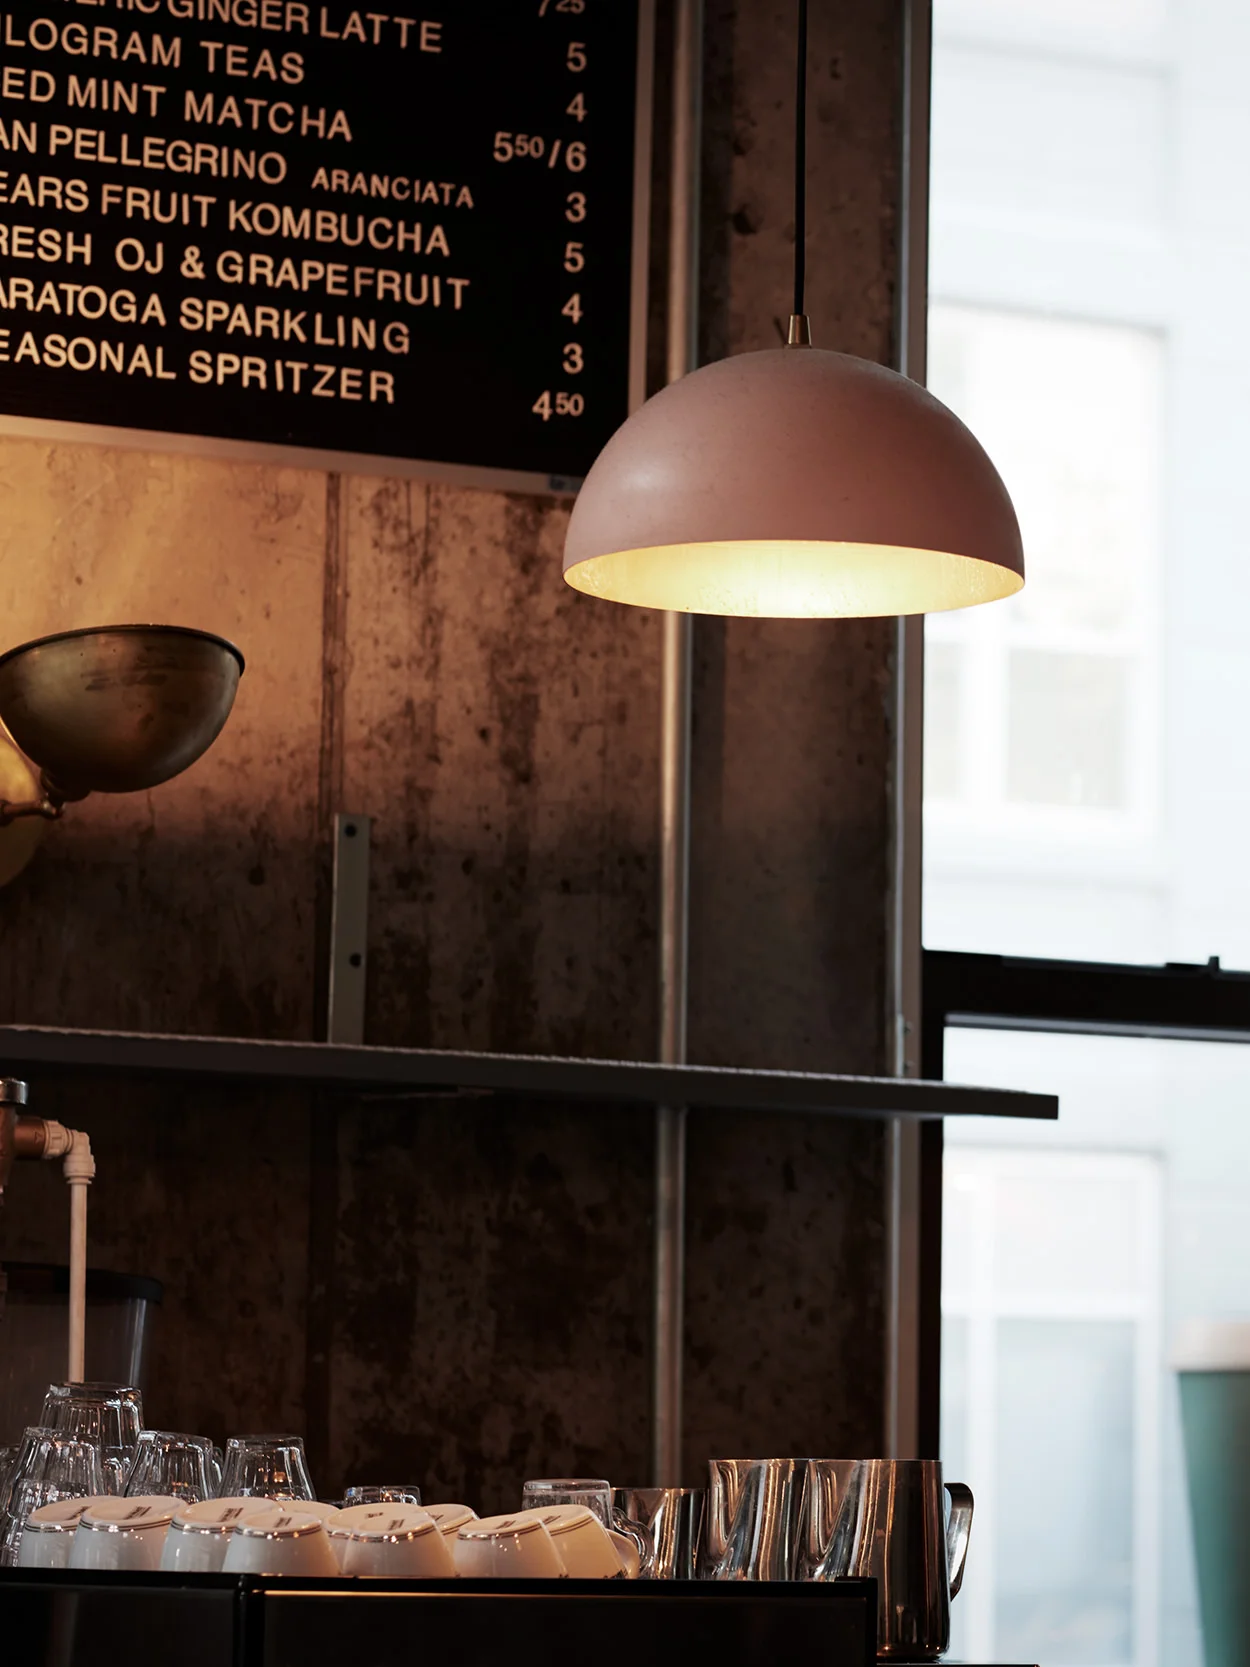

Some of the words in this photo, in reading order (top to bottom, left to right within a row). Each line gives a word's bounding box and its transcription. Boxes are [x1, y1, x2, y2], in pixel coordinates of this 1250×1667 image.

[5, 14, 182, 69] LOGRAM
[199, 40, 305, 85] TEAS
[566, 93, 586, 122] 4
[166, 0, 309, 35] GINGER
[319, 6, 442, 53] LATTE
[567, 42, 586, 72] 5
[1, 65, 56, 103] ED
[67, 74, 167, 118] MINT
[184, 89, 353, 142] MATCHA
[48, 123, 287, 185] PELLEGRINO
[311, 166, 474, 209] ARANCIATA
[565, 191, 586, 223] 3
[100, 183, 217, 228] FRUIT
[228, 199, 450, 257] KOMBUCHA
[563, 241, 585, 273] 5
[114, 237, 164, 275] OJ
[179, 245, 206, 280] &
[215, 249, 470, 310] GRAPEFRUIT
[561, 293, 583, 324] 4
[178, 296, 410, 355] SPARKLING
[562, 342, 584, 374] 3
[188, 349, 395, 404] SPRITZER
